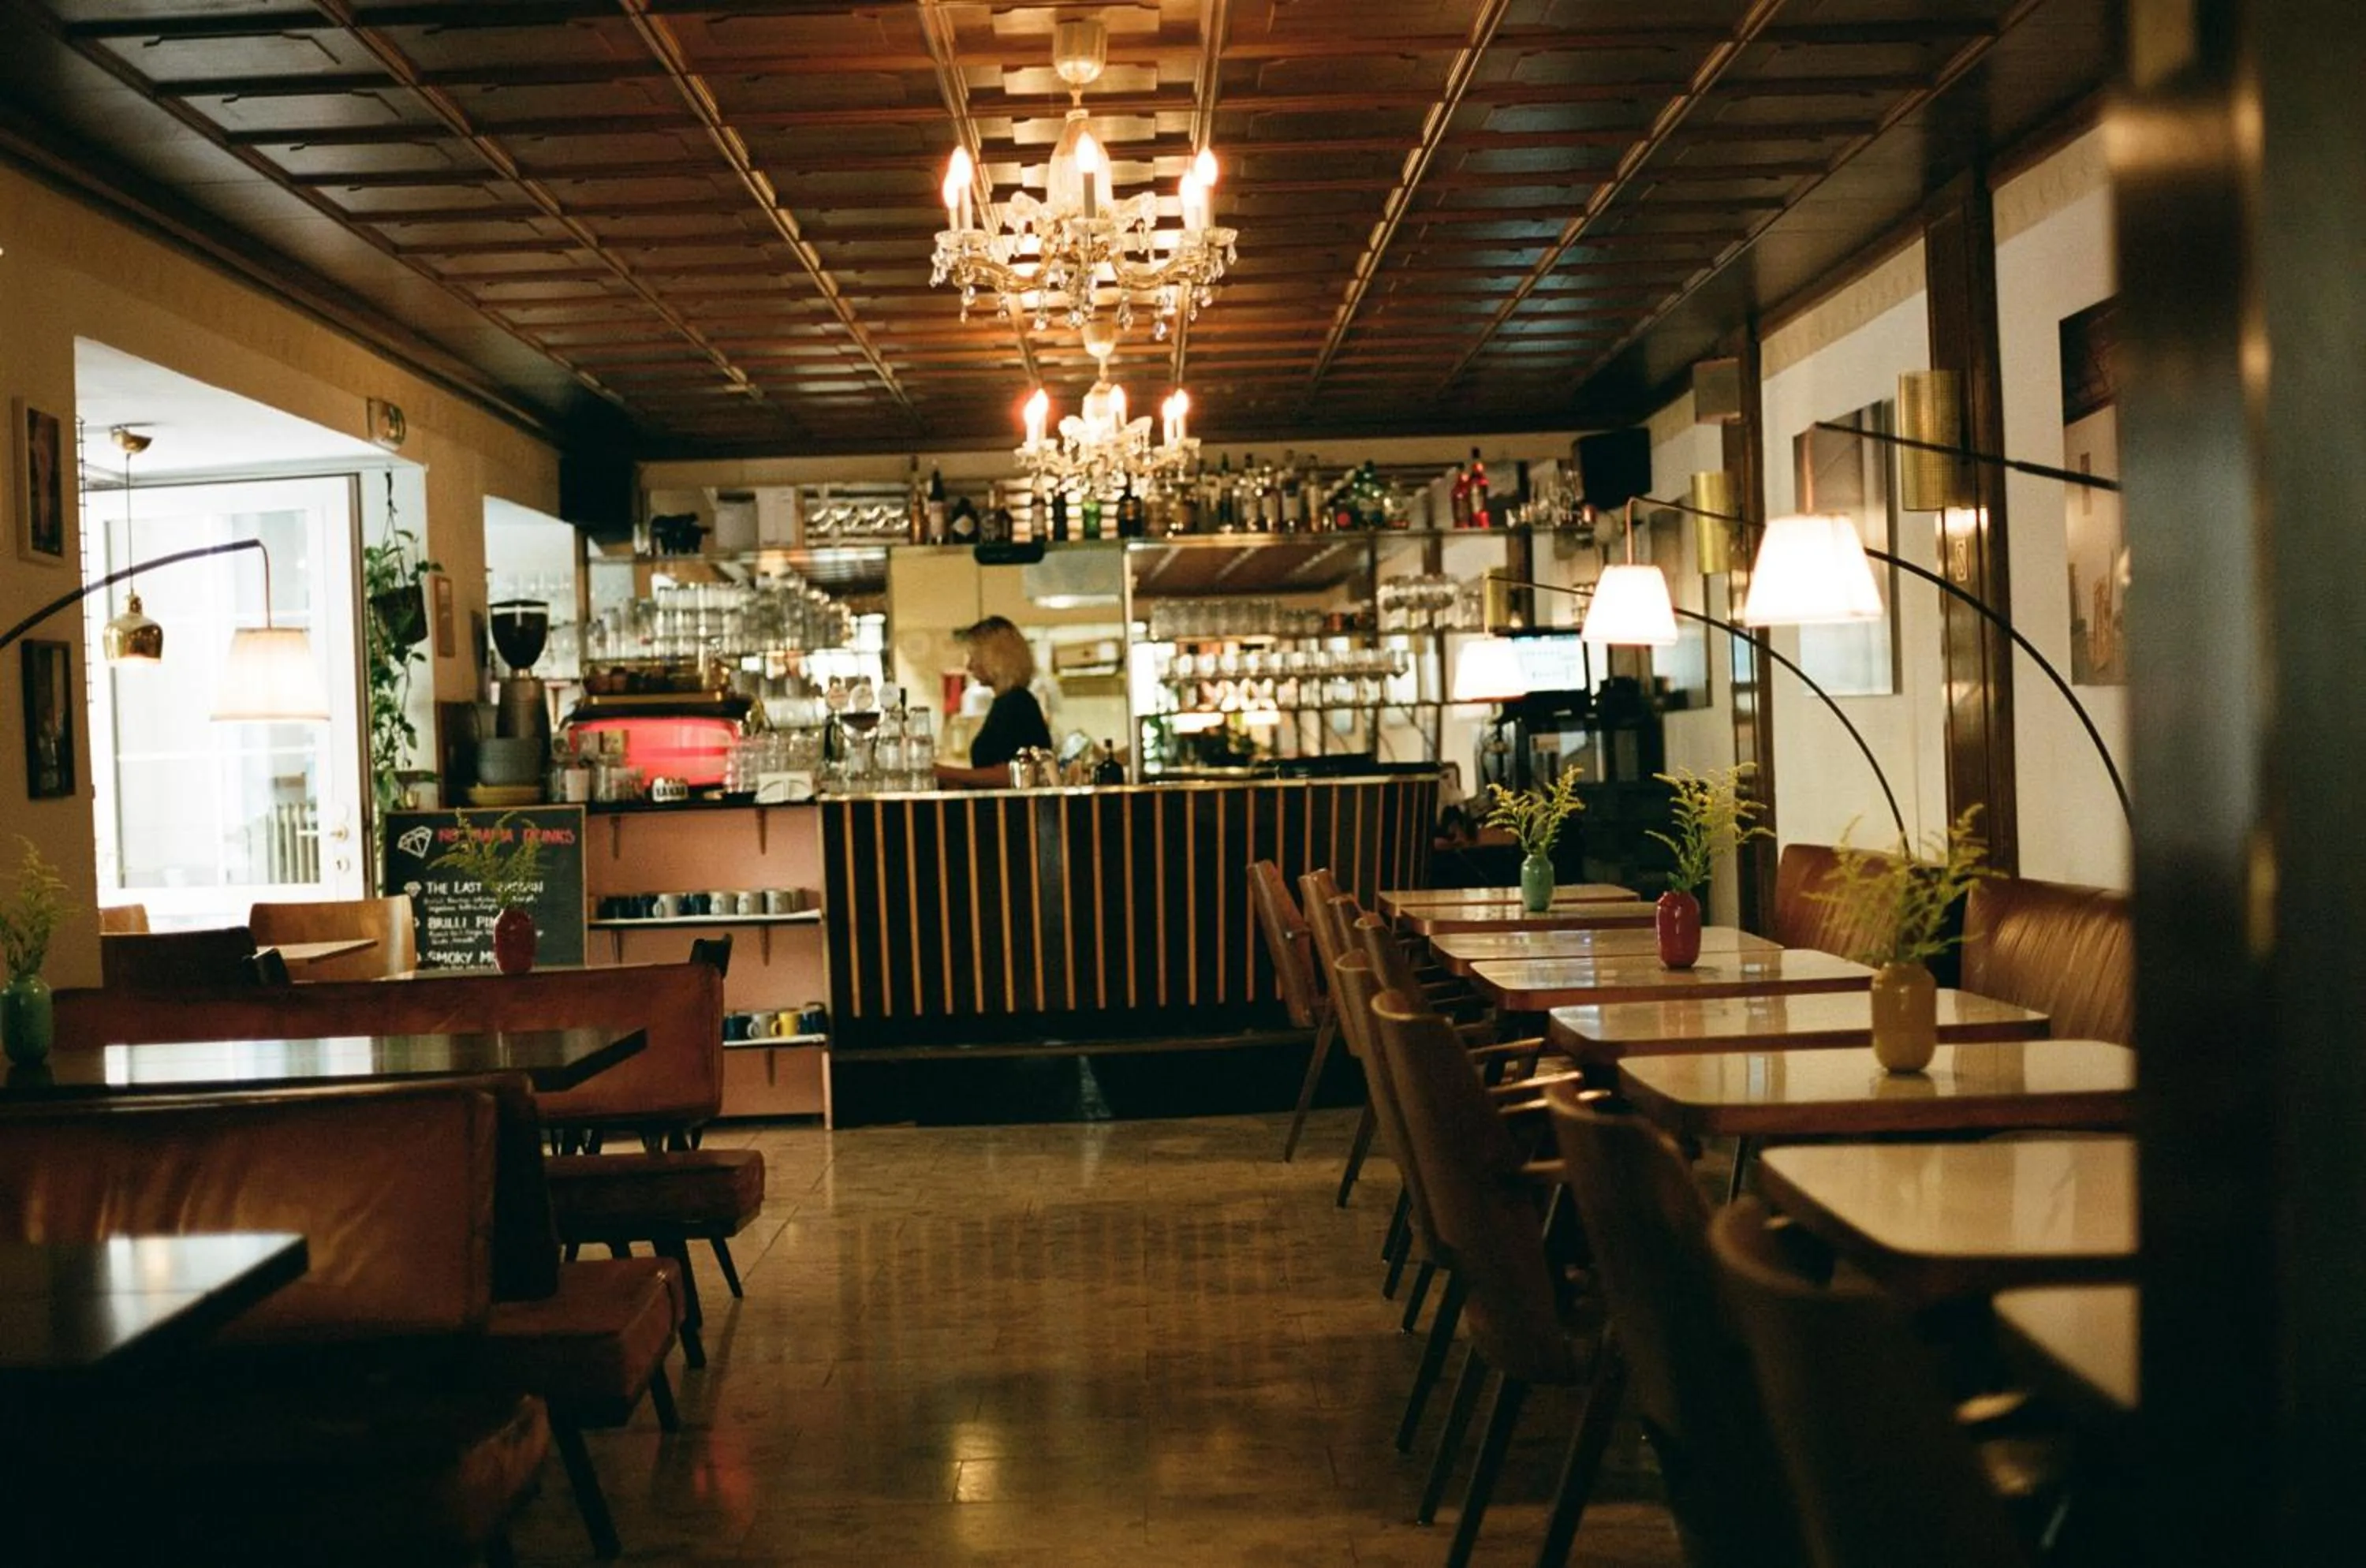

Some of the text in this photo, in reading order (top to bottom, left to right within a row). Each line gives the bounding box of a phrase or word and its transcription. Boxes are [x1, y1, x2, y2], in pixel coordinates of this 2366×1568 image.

[426, 881, 448, 894] THE
[453, 880, 482, 893] LAST
[427, 950, 473, 964] SMOKY
